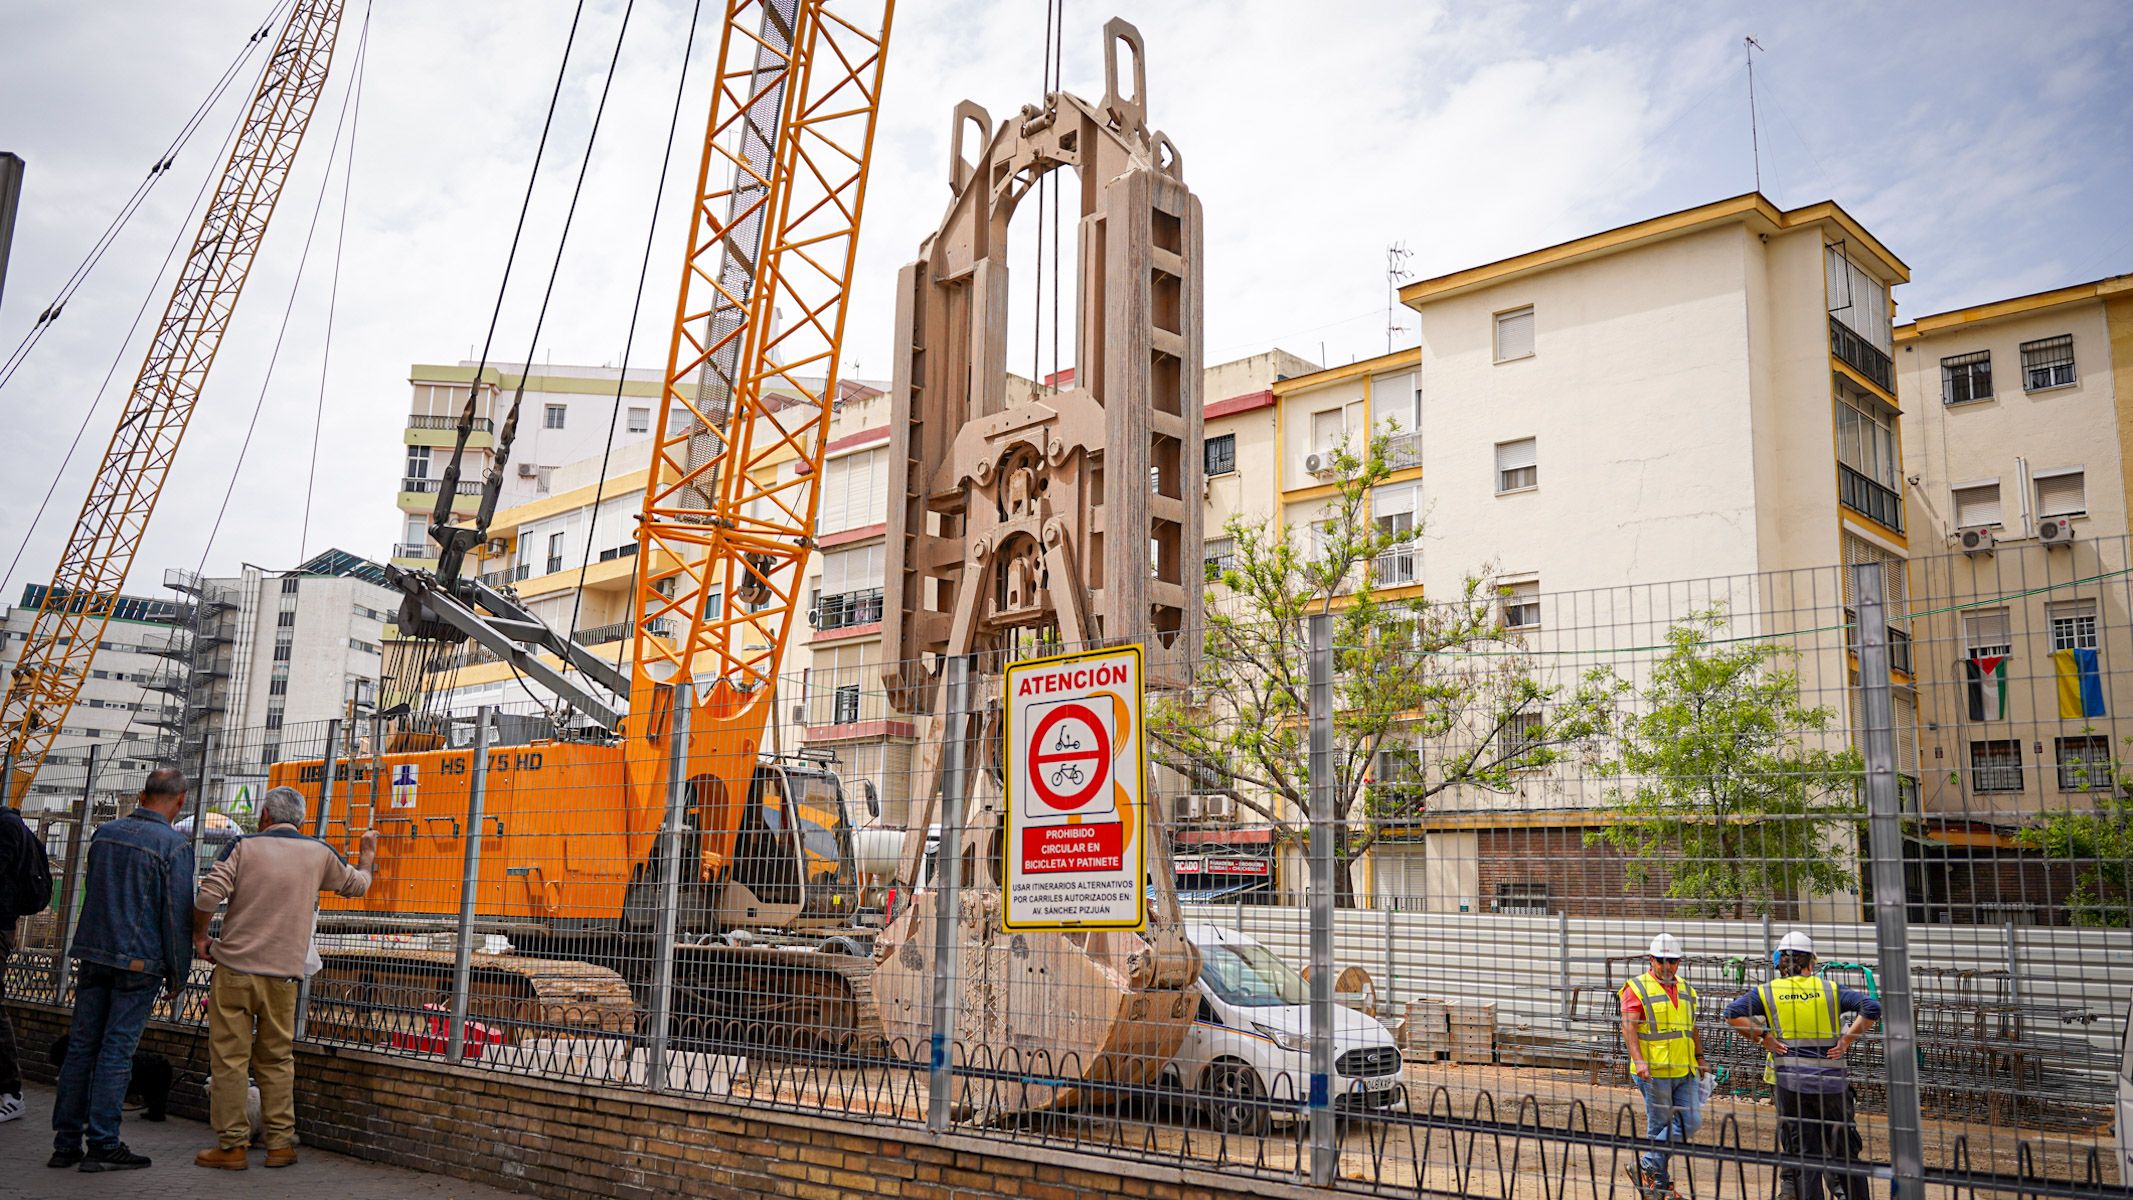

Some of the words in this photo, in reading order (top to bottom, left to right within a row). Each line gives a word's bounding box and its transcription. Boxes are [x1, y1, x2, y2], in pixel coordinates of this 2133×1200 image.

[1018, 662, 1127, 697] ATENCIÓN
[441, 757, 465, 776] HS
[486, 754, 509, 773] 75
[515, 752, 543, 771] HD
[1045, 828, 1095, 839] PROHIBIDO
[1041, 843, 1086, 854] CIRCULAR
[1087, 842, 1100, 852] EN
[1024, 859, 1067, 869] BICICLETA
[1068, 858, 1075, 868] Y
[1076, 856, 1119, 867] PATINETE
[1012, 883, 1031, 892] USAR
[1032, 881, 1076, 891] ITINERARIOS
[1077, 880, 1134, 889] ALTERNATIVOS
[1013, 895, 1028, 903] POR
[1029, 894, 1063, 903] CARRILES
[1064, 893, 1117, 902] AUTORIZADOS
[1119, 892, 1132, 901] EN:
[1032, 907, 1043, 915] AV.
[1044, 905, 1077, 914] SÁNCHEZ
[1079, 904, 1111, 914] PIZJUÁN
